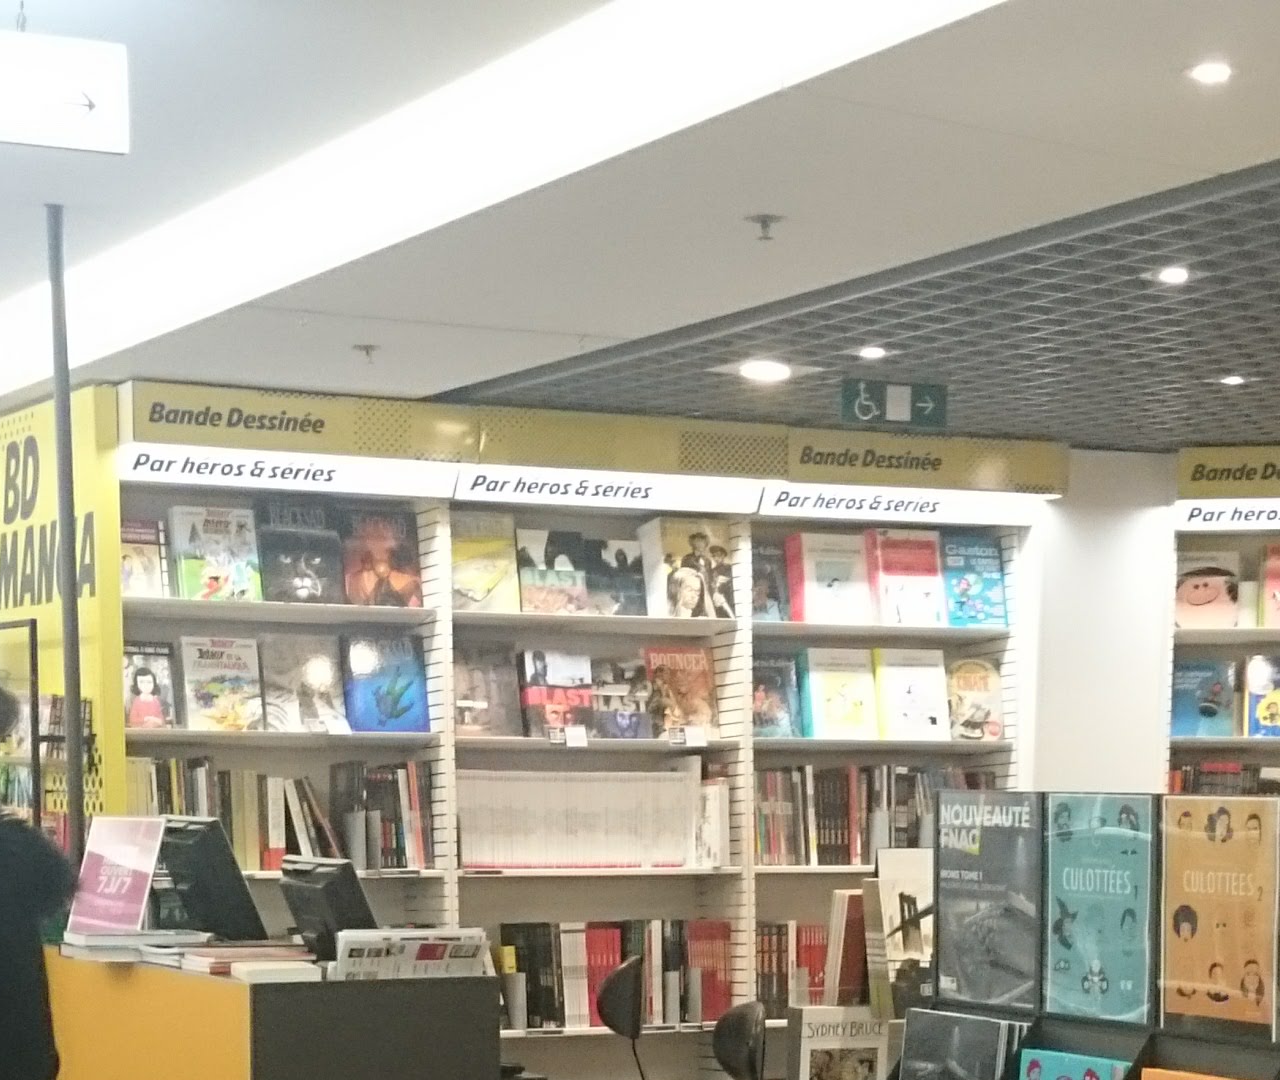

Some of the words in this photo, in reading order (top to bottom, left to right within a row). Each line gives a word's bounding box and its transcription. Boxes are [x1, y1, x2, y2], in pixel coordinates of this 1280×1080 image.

[148, 402, 223, 427] Bande
[226, 407, 326, 434] Dessinée
[132, 453, 177, 473] Par
[250, 460, 266, 478] &
[799, 446, 859, 467] Bande
[861, 449, 943, 471] Dessinée
[3, 435, 40, 525] BD
[1190, 462, 1258, 482] Bande
[470, 475, 509, 493] Par
[575, 479, 589, 496] &
[774, 490, 812, 508] Par
[869, 494, 883, 511] &
[1187, 506, 1227, 522] Par
[650, 652, 710, 671] BOUNCER
[940, 801, 1031, 828] NOUVEAUTÉ
[940, 827, 981, 850] FNAC
[1062, 865, 1132, 895] CULOTTÉES
[806, 1022, 848, 1038] SYDNEY
